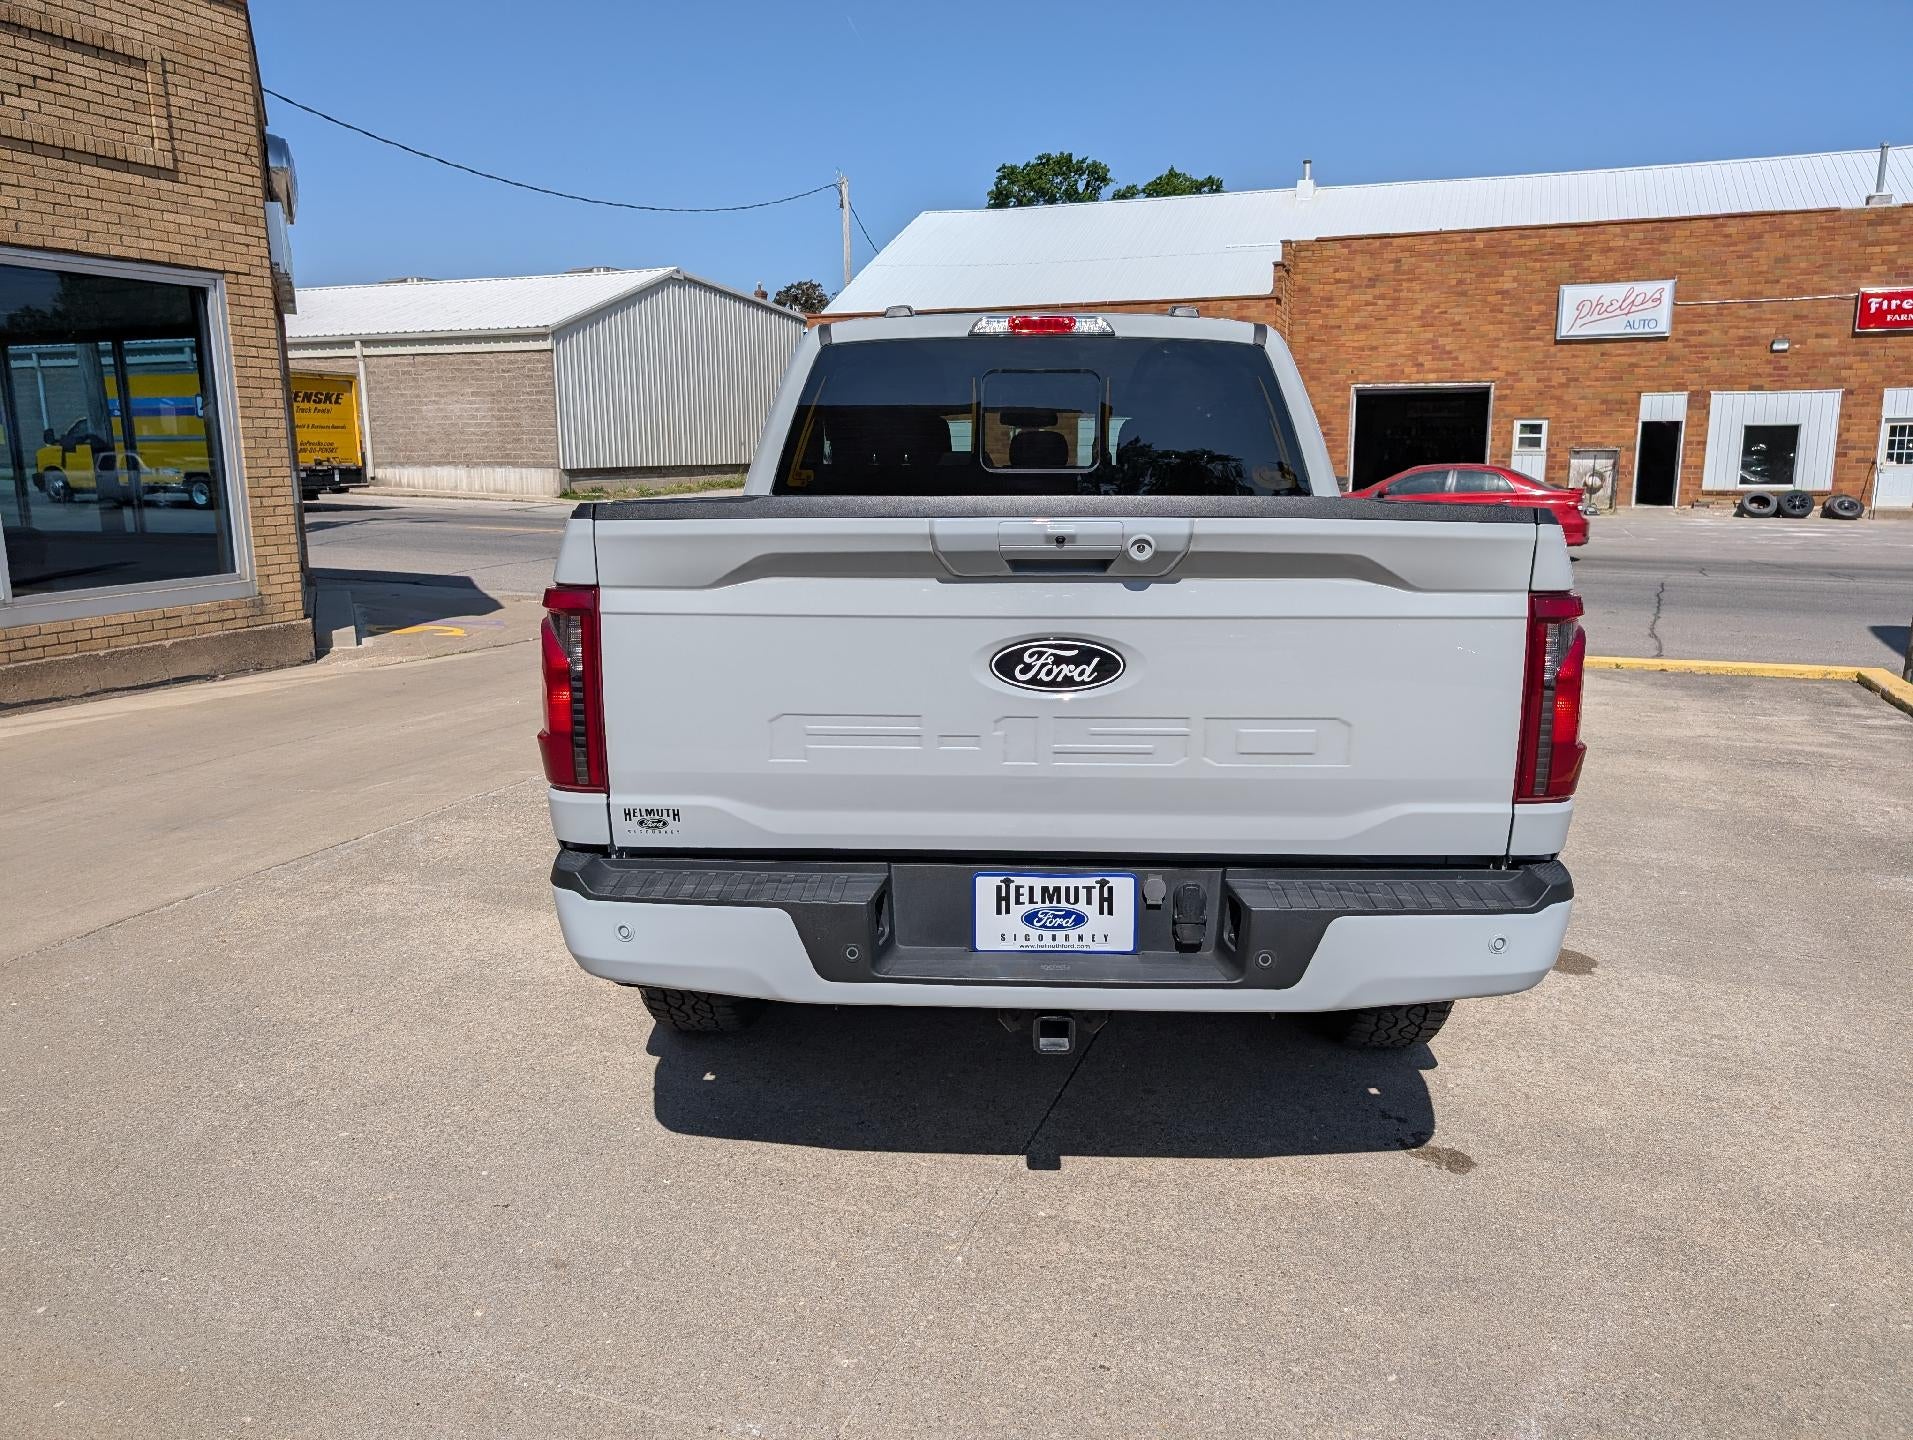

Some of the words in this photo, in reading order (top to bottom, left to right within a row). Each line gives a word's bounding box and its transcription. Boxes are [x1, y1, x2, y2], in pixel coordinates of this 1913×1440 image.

[1624, 318, 1658, 330] AUTO
[293, 390, 344, 405] ENSKE
[1014, 647, 1101, 682] Ford
[768, 713, 1353, 768] F-150
[623, 807, 681, 822] HELMUTH
[642, 819, 664, 828] Ford
[995, 878, 1114, 916] HELMUTH
[1033, 909, 1077, 928] Ford
[1000, 933, 1109, 943] SIGOURNEY
